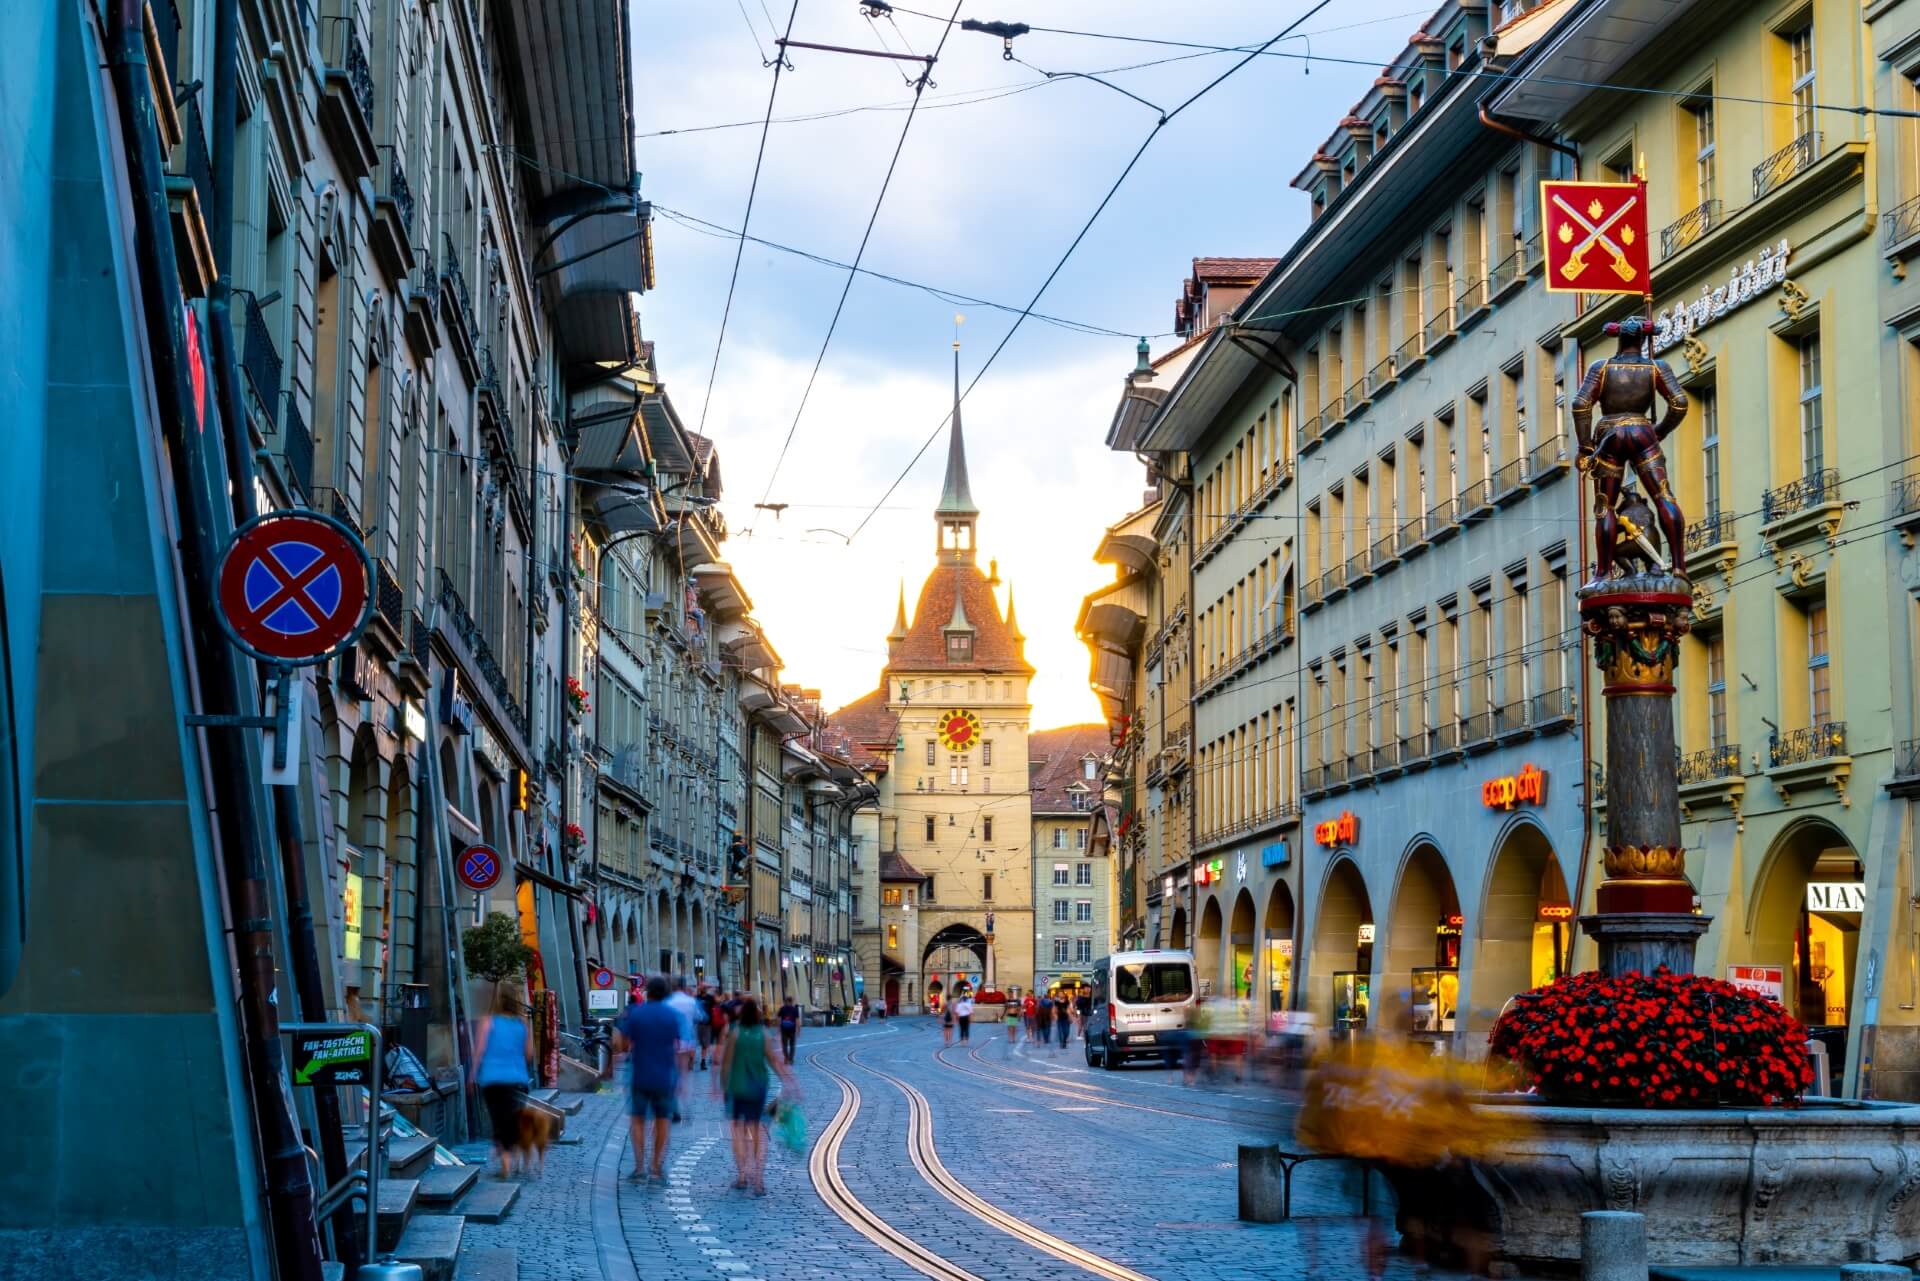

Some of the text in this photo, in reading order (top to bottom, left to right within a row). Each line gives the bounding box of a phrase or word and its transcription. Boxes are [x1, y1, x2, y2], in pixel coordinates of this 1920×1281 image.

[1483, 763, 1542, 810] coop city
[1315, 820, 1337, 848] coop
[1541, 907, 1571, 918] coop
[1449, 916, 1465, 925] co
[303, 1036, 365, 1051] FAN-TASTISCHE
[313, 1046, 364, 1059] FAN-ARTIKEL
